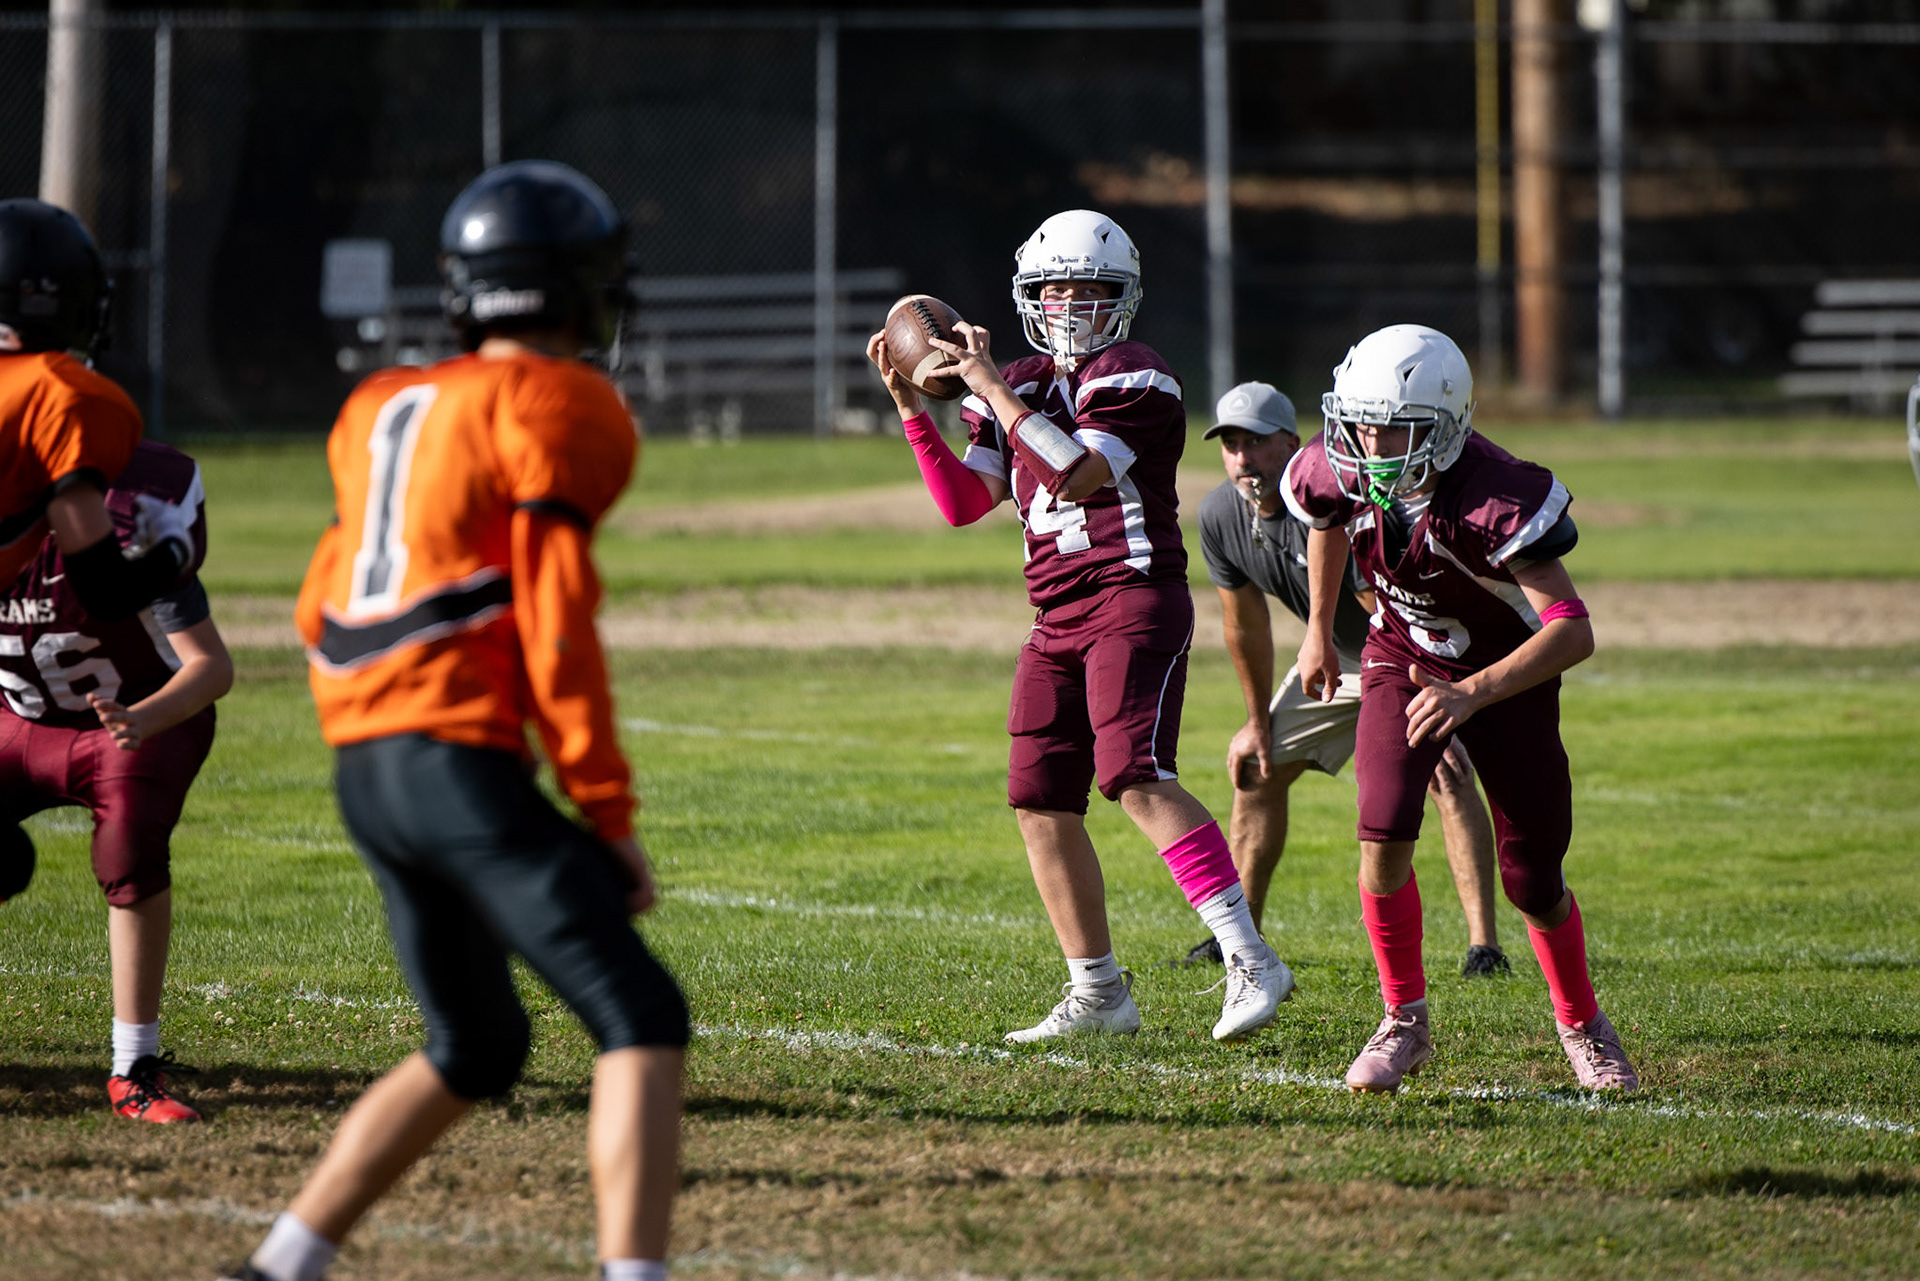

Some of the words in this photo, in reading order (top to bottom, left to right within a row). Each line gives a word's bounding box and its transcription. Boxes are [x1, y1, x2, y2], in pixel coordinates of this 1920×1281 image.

[346, 383, 438, 616] 1
[1372, 569, 1436, 606] RAMS
[0, 631, 122, 718] 56
